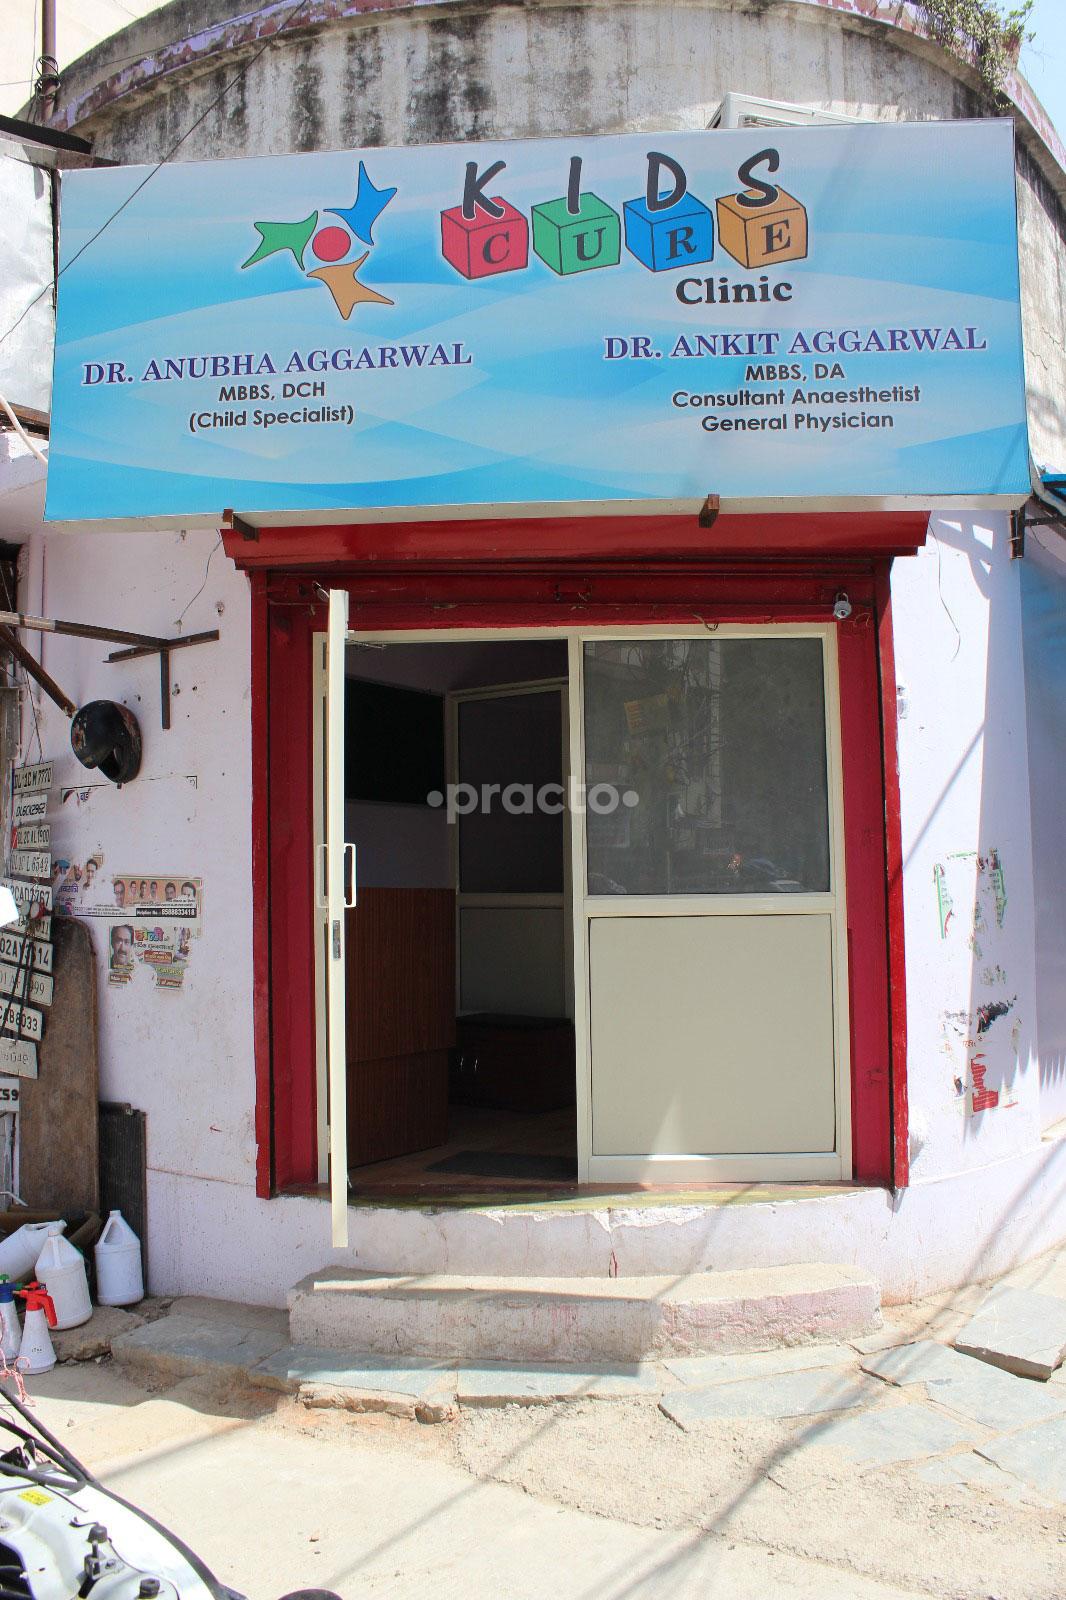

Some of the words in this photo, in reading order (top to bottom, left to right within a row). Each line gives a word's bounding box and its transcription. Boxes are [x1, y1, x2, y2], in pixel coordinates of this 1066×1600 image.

[462, 148, 780, 220] KIDS
[483, 219, 792, 265] CURE
[676, 275, 793, 305] Clinic
[604, 336, 662, 359] DR.
[670, 333, 780, 357] ANKIT
[788, 327, 988, 354] AGGARWAL
[83, 362, 134, 385] DR.
[141, 352, 277, 381] ANUBHA
[284, 343, 473, 373] AGGARWAL
[745, 364, 808, 382] MBBS,
[814, 363, 845, 379] DA
[218, 384, 276, 402] MBBS,
[282, 381, 325, 399] DCH
[672, 389, 785, 408] Consultant
[791, 385, 921, 405] Anaesthetist
[189, 410, 247, 433] (Child
[253, 404, 354, 429] Specialist)
[701, 414, 787, 432] General
[794, 411, 894, 433] Physician
